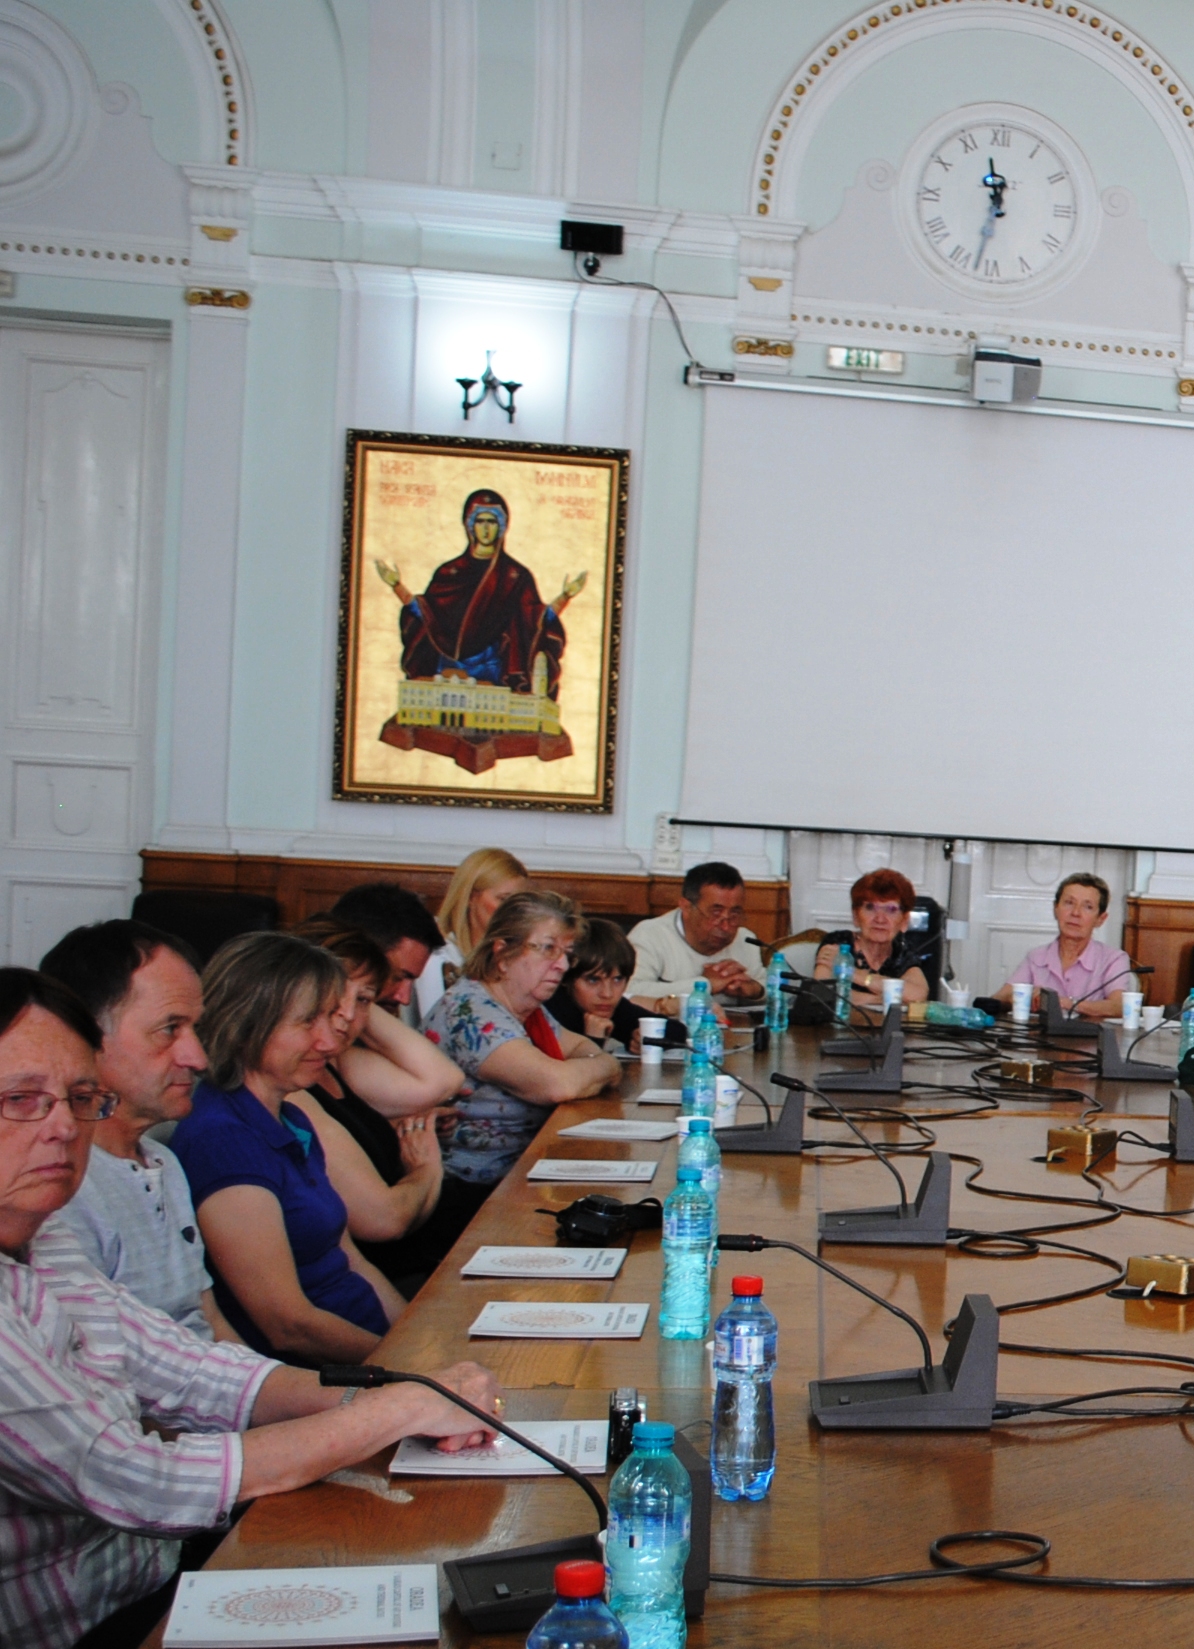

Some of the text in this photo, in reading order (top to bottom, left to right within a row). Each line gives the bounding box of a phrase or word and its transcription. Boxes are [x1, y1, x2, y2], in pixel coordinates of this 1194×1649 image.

[959, 132, 979, 153] XI
[989, 128, 1011, 147] XII
[934, 155, 953, 172] X
[1047, 171, 1066, 185] II
[921, 185, 942, 202] IX
[1053, 204, 1072, 219] III
[926, 216, 950, 245] VIII
[1042, 233, 1062, 254] IV
[949, 245, 972, 269] VII
[1018, 255, 1032, 273] V
[984, 259, 1000, 277] VI
[845, 347, 881, 368] EXIT
